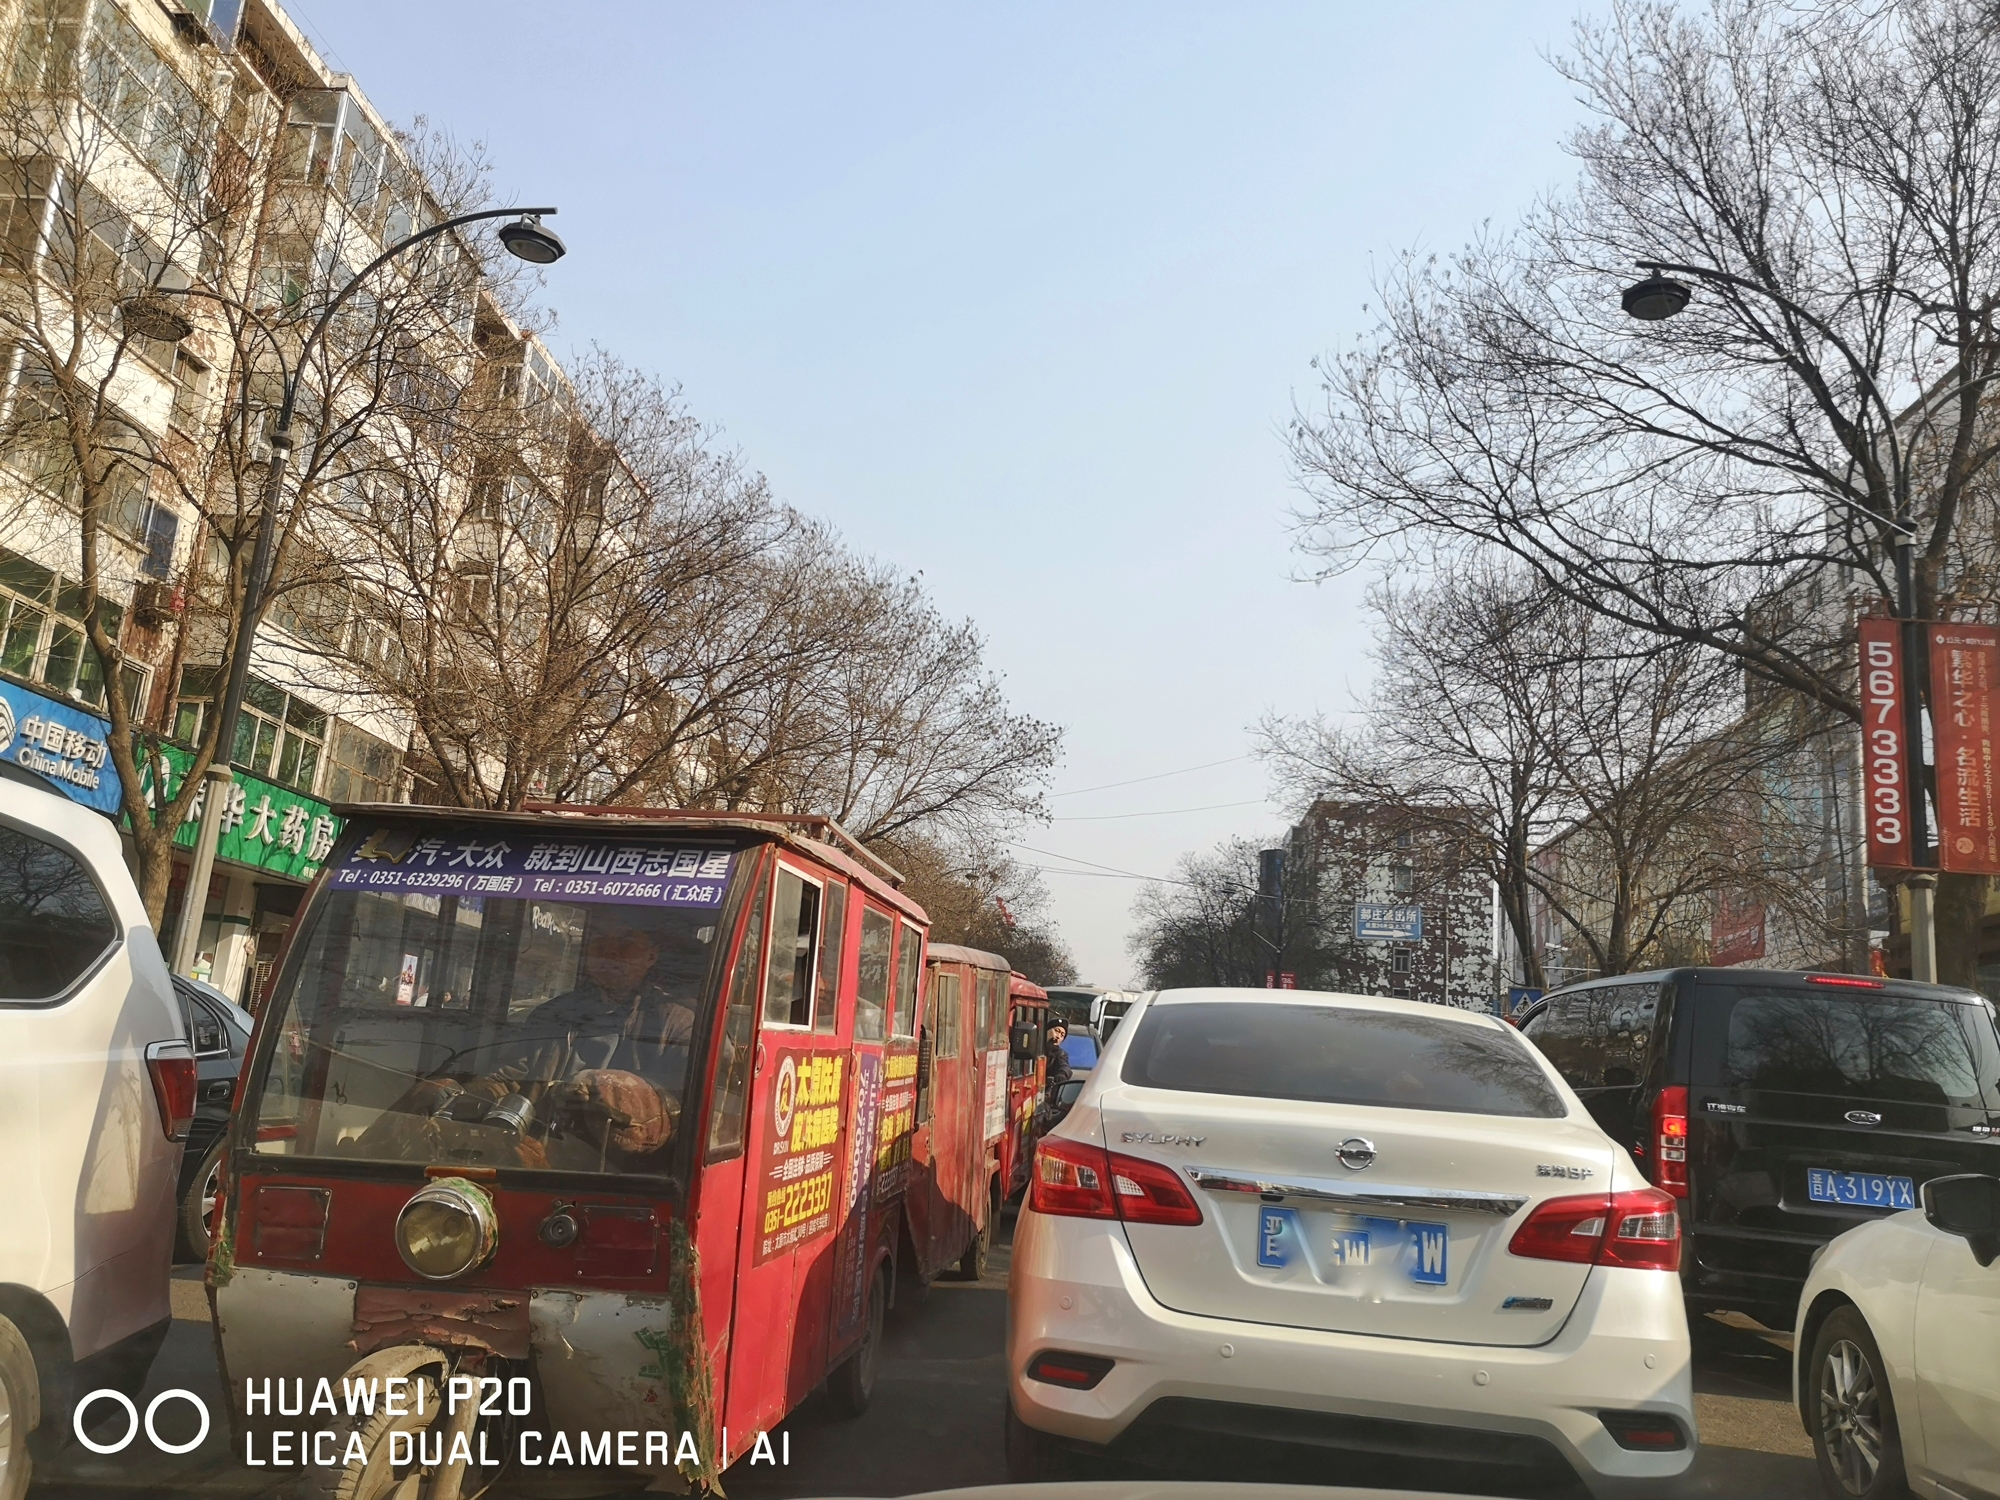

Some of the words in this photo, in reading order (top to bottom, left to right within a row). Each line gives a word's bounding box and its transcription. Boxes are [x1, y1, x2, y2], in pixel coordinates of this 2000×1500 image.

[21, 715, 107, 769] 中国移动
[1867, 640, 1902, 845] 5673333
[17, 747, 57, 775] China
[58, 760, 100, 790] Mobile
[523, 842, 732, 880] 就到山西志国星
[1121, 1132, 1206, 1147] SYLPHY
